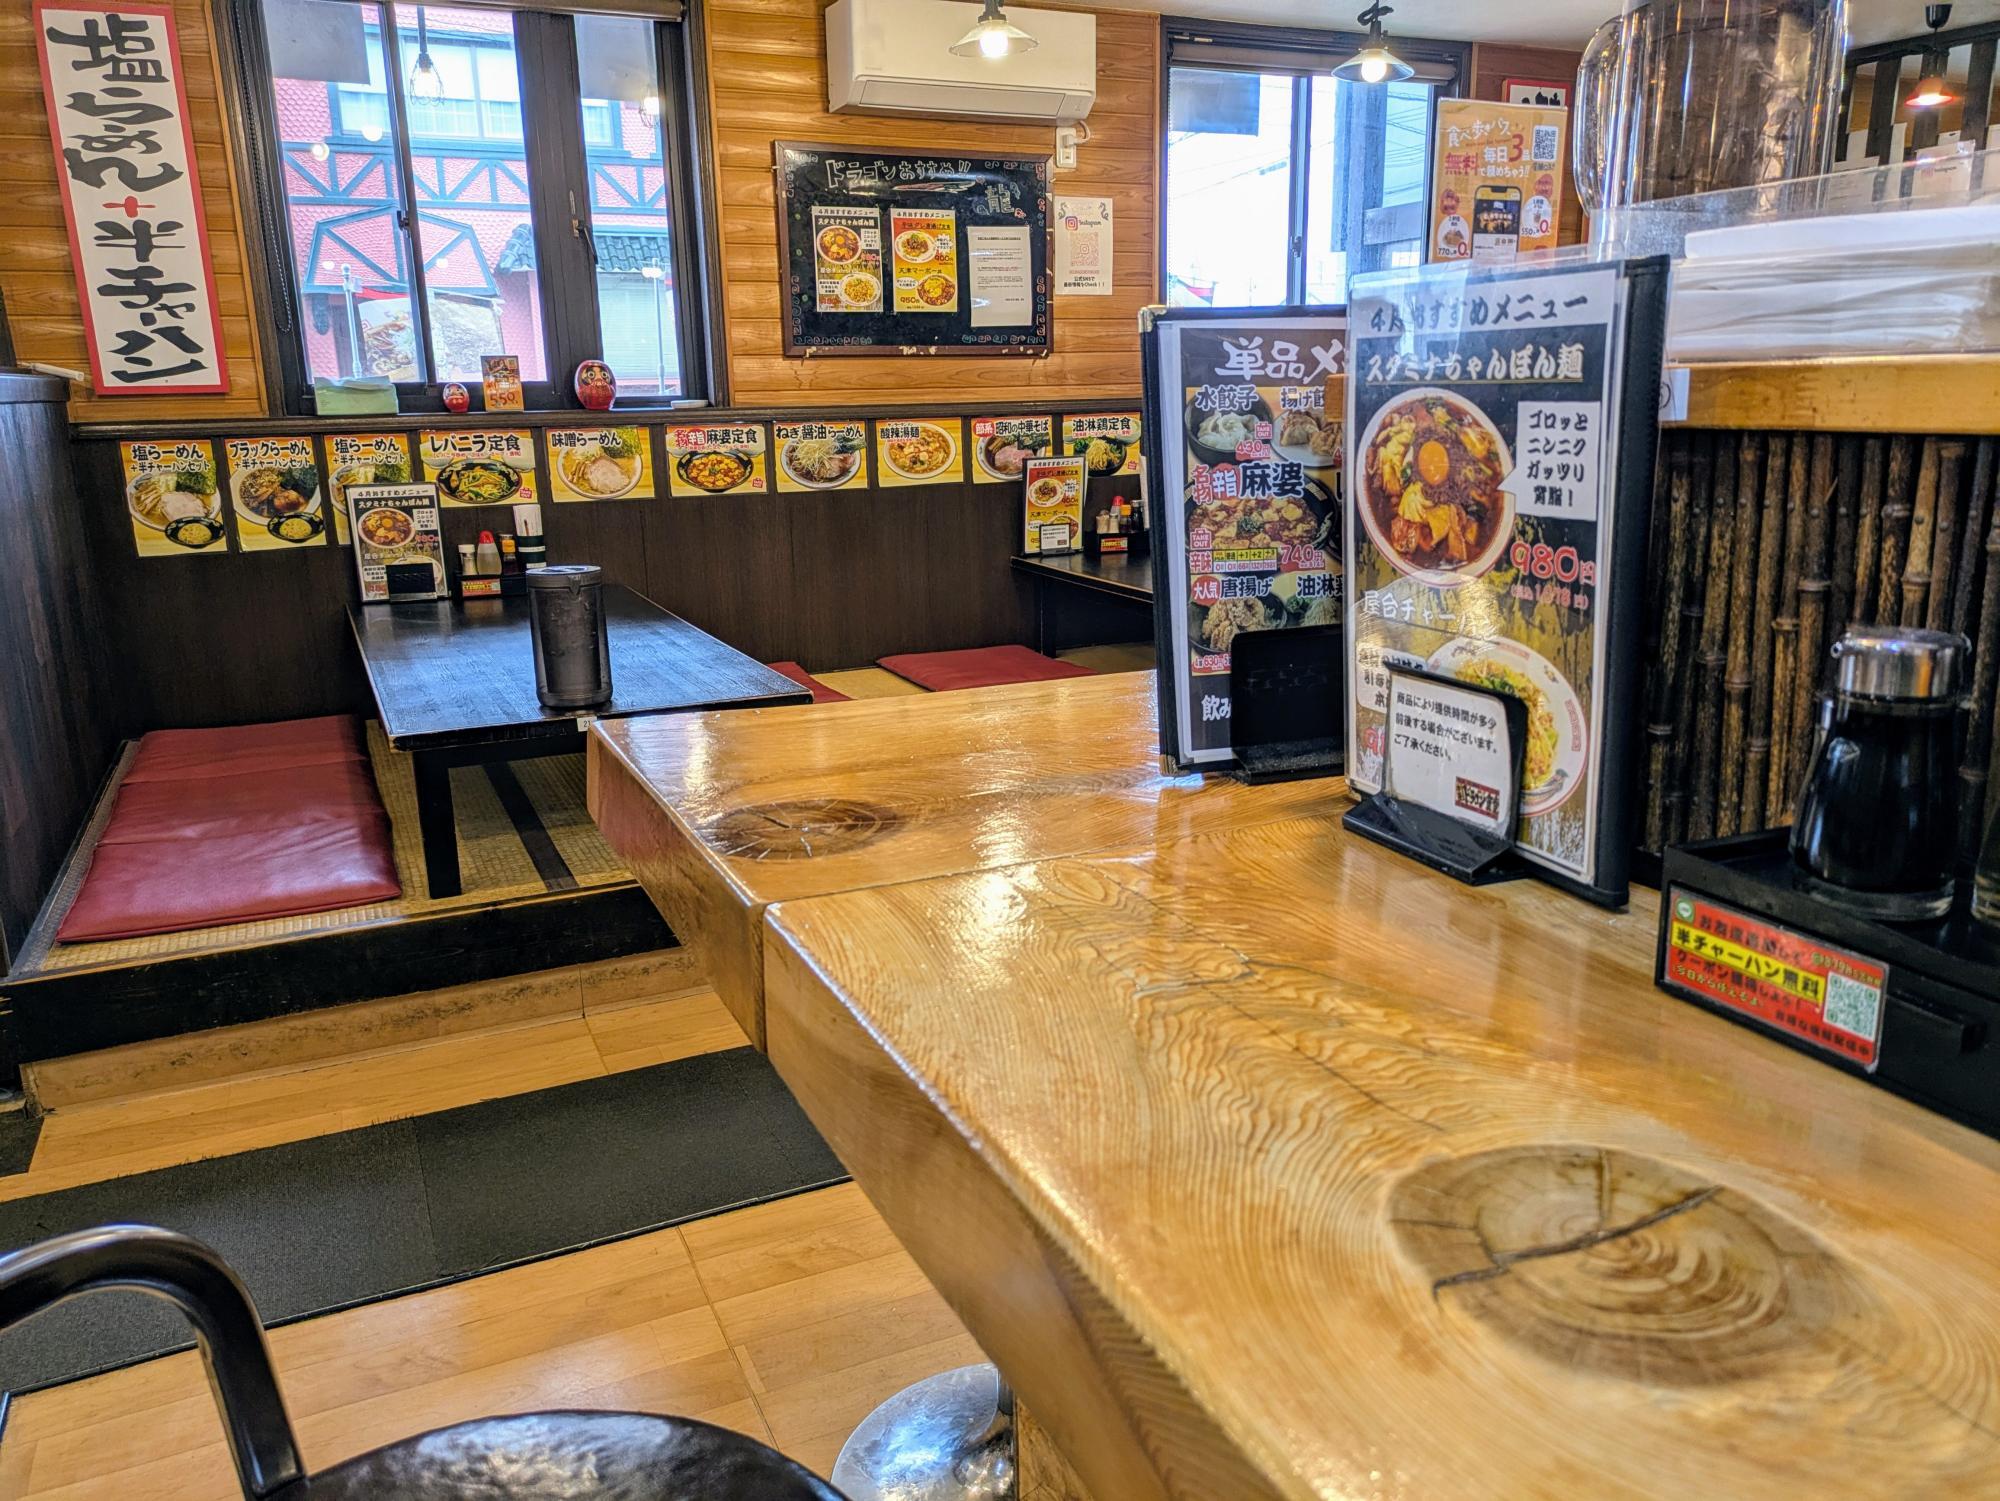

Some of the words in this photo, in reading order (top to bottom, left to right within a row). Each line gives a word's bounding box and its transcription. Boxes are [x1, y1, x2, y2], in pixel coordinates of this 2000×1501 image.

[1215, 336, 1344, 384] 単品メ
[1366, 342, 1584, 381] スタミナちゃんぽん麺
[1197, 385, 1258, 410] 水餃子
[1073, 416, 1131, 431] 油淋鶏定食
[1529, 410, 1588, 431] ゴロッと
[430, 434, 521, 452] レバニラ定食
[551, 431, 622, 447] 味噌らーめん
[776, 425, 863, 440] ねぎ醤油らーめん
[132, 444, 203, 460] 塩らーめん
[229, 441, 311, 457] ブラックらーめん
[335, 438, 400, 453] 塩らーめん
[1527, 437, 1586, 457] ニンニク
[1527, 460, 1585, 483] ガッツリ
[1193, 464, 1212, 505] 名物
[1240, 461, 1304, 498] 麻婆
[1190, 551, 1213, 573] 辛味
[1281, 544, 1324, 564] 740円
[1510, 541, 1596, 586] 980円
[1193, 579, 1218, 599] 大人気
[1221, 576, 1273, 599] 唐揚げ
[1396, 691, 1497, 729] 商品により提供時間が多少
[1394, 712, 1498, 754] 前後する場合がございます。
[1393, 733, 1452, 761] ご了承ください。
[1676, 926, 1820, 998] 半チャーハン無料
